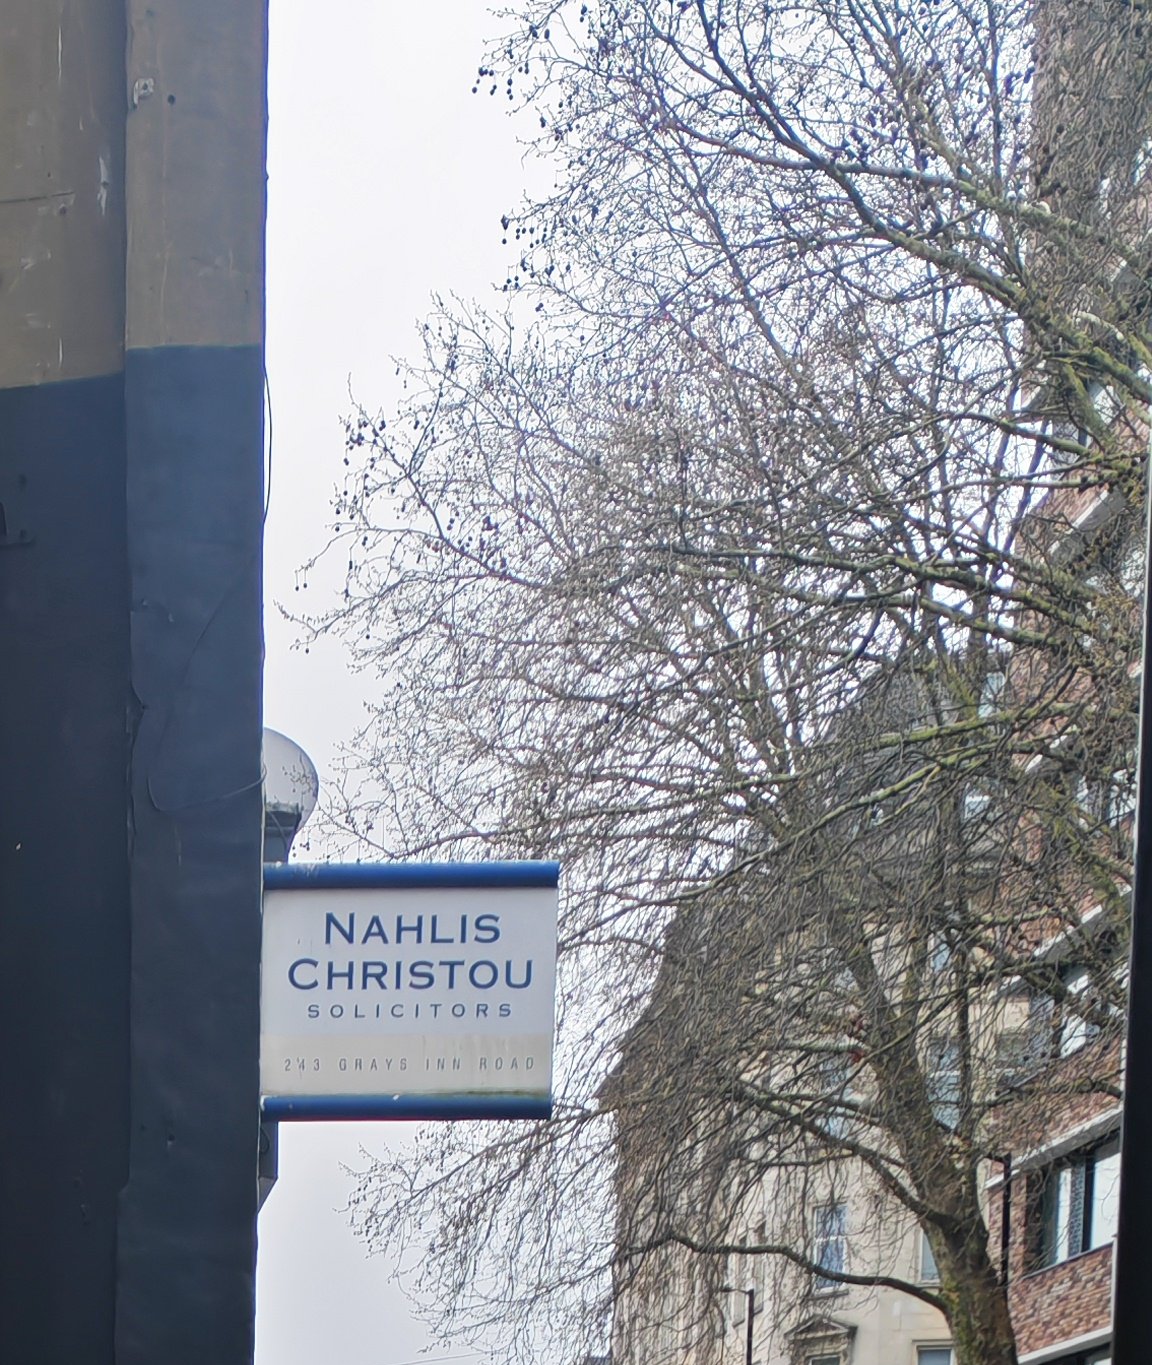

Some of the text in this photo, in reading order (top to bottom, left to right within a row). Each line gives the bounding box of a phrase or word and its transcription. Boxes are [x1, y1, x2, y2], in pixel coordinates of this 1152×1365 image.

[325, 912, 501, 945] NAHLIS
[288, 958, 533, 990] CHRISTOU
[308, 1003, 512, 1018] SOLICITORS
[339, 1058, 407, 1071] GRAYS
[425, 1057, 461, 1071] INN
[479, 1056, 534, 1071] ROAD
